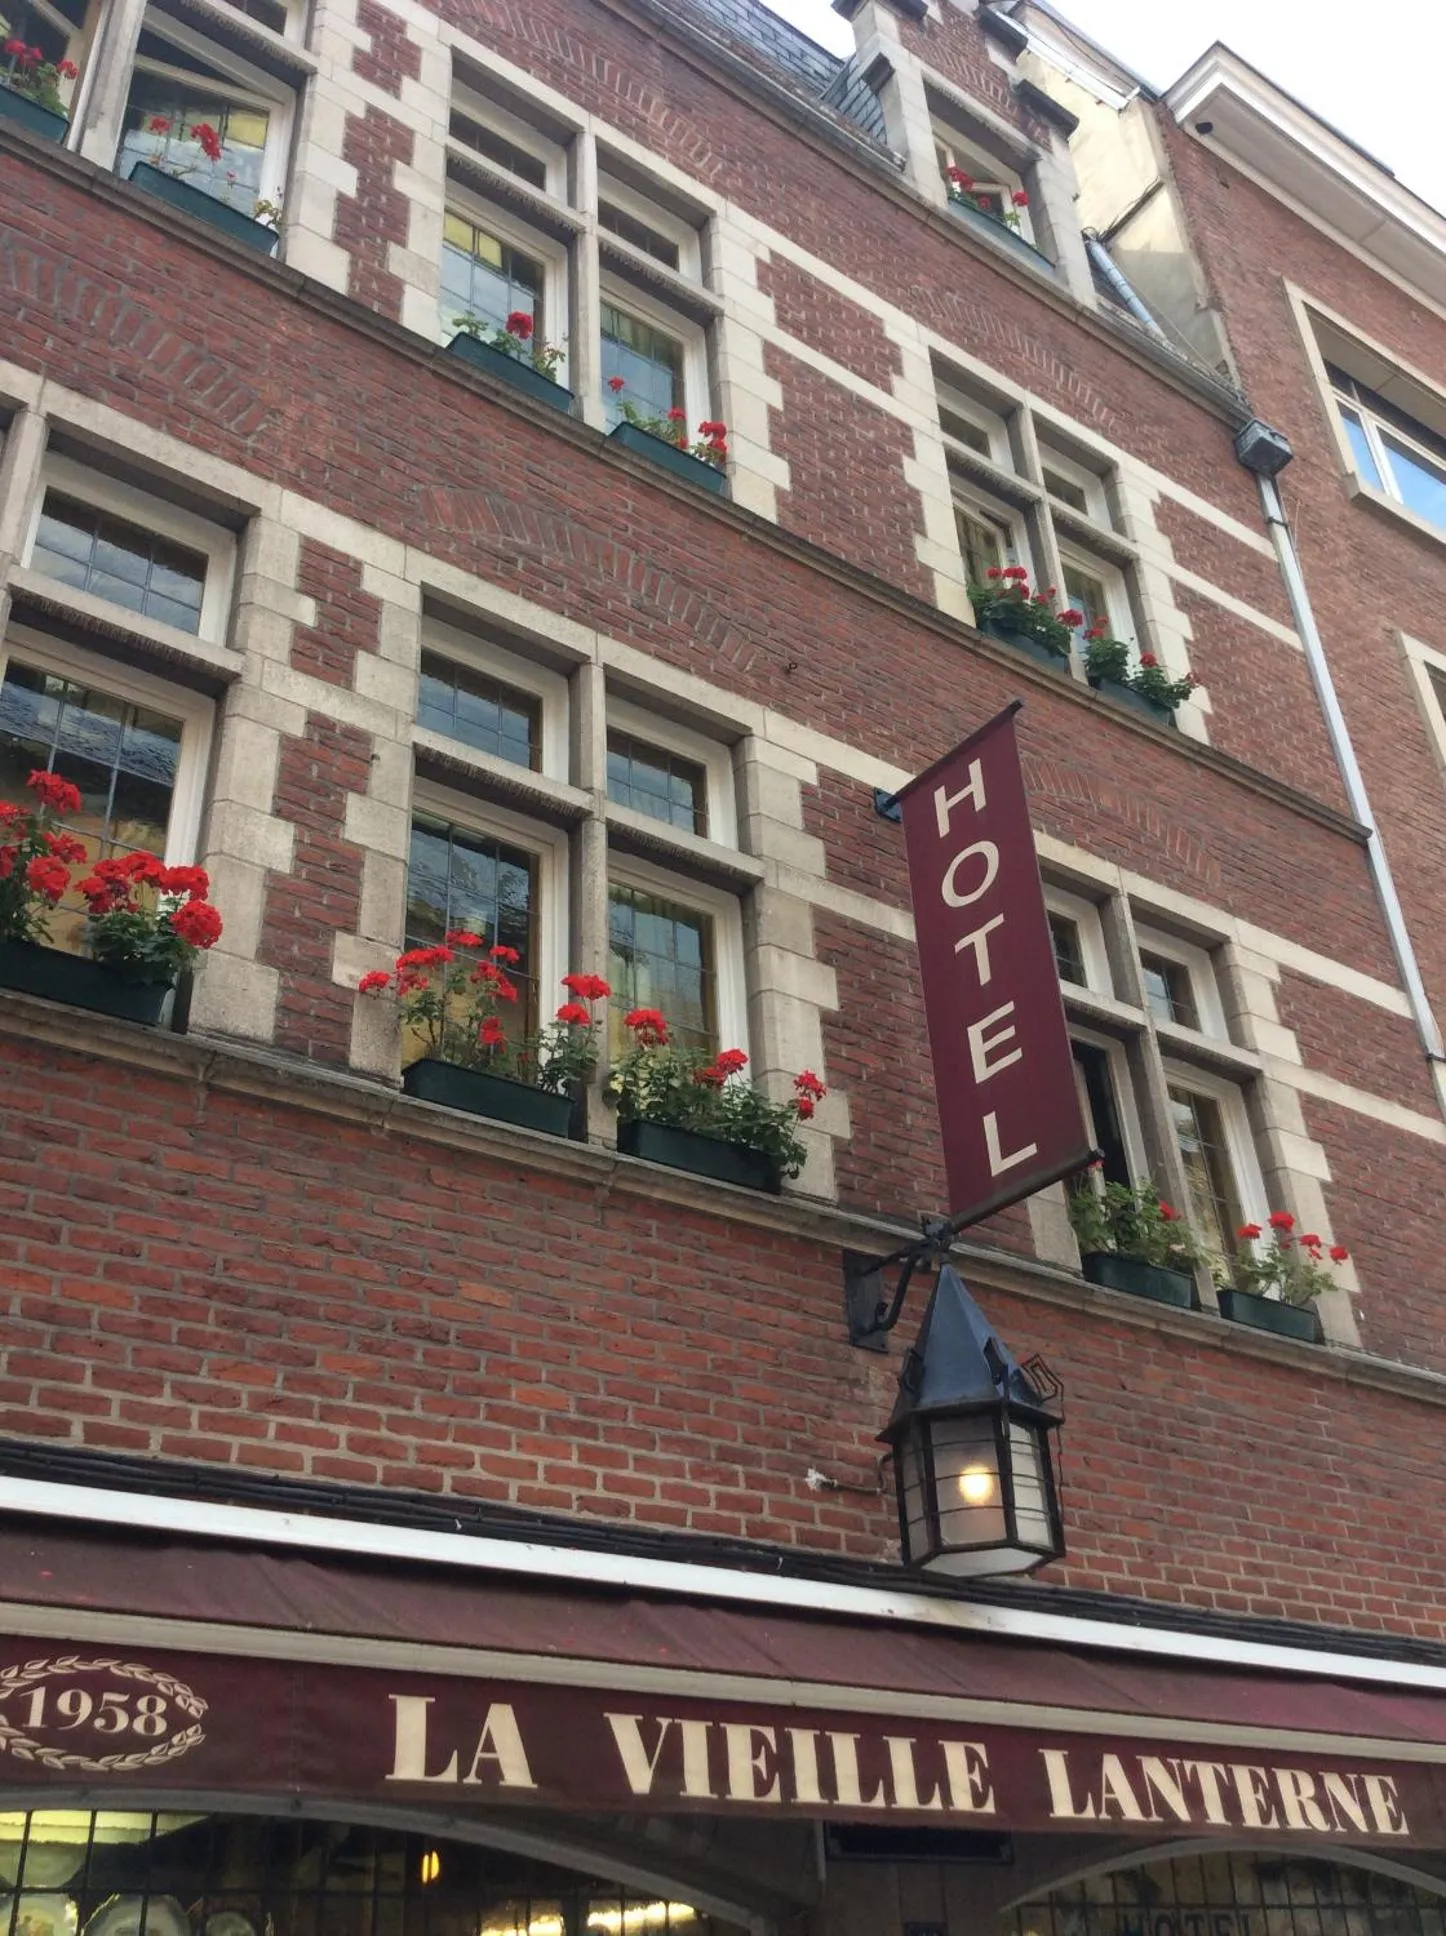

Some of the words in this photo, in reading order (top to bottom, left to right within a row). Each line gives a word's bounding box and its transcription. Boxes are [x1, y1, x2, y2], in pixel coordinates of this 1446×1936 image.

[934, 758, 1038, 1177] HOTEL
[18, 1686, 168, 1737] 1958
[385, 1694, 538, 1788] LA
[603, 1711, 996, 1814] VIEILLE
[1038, 1748, 1410, 1835] LANTERNE
